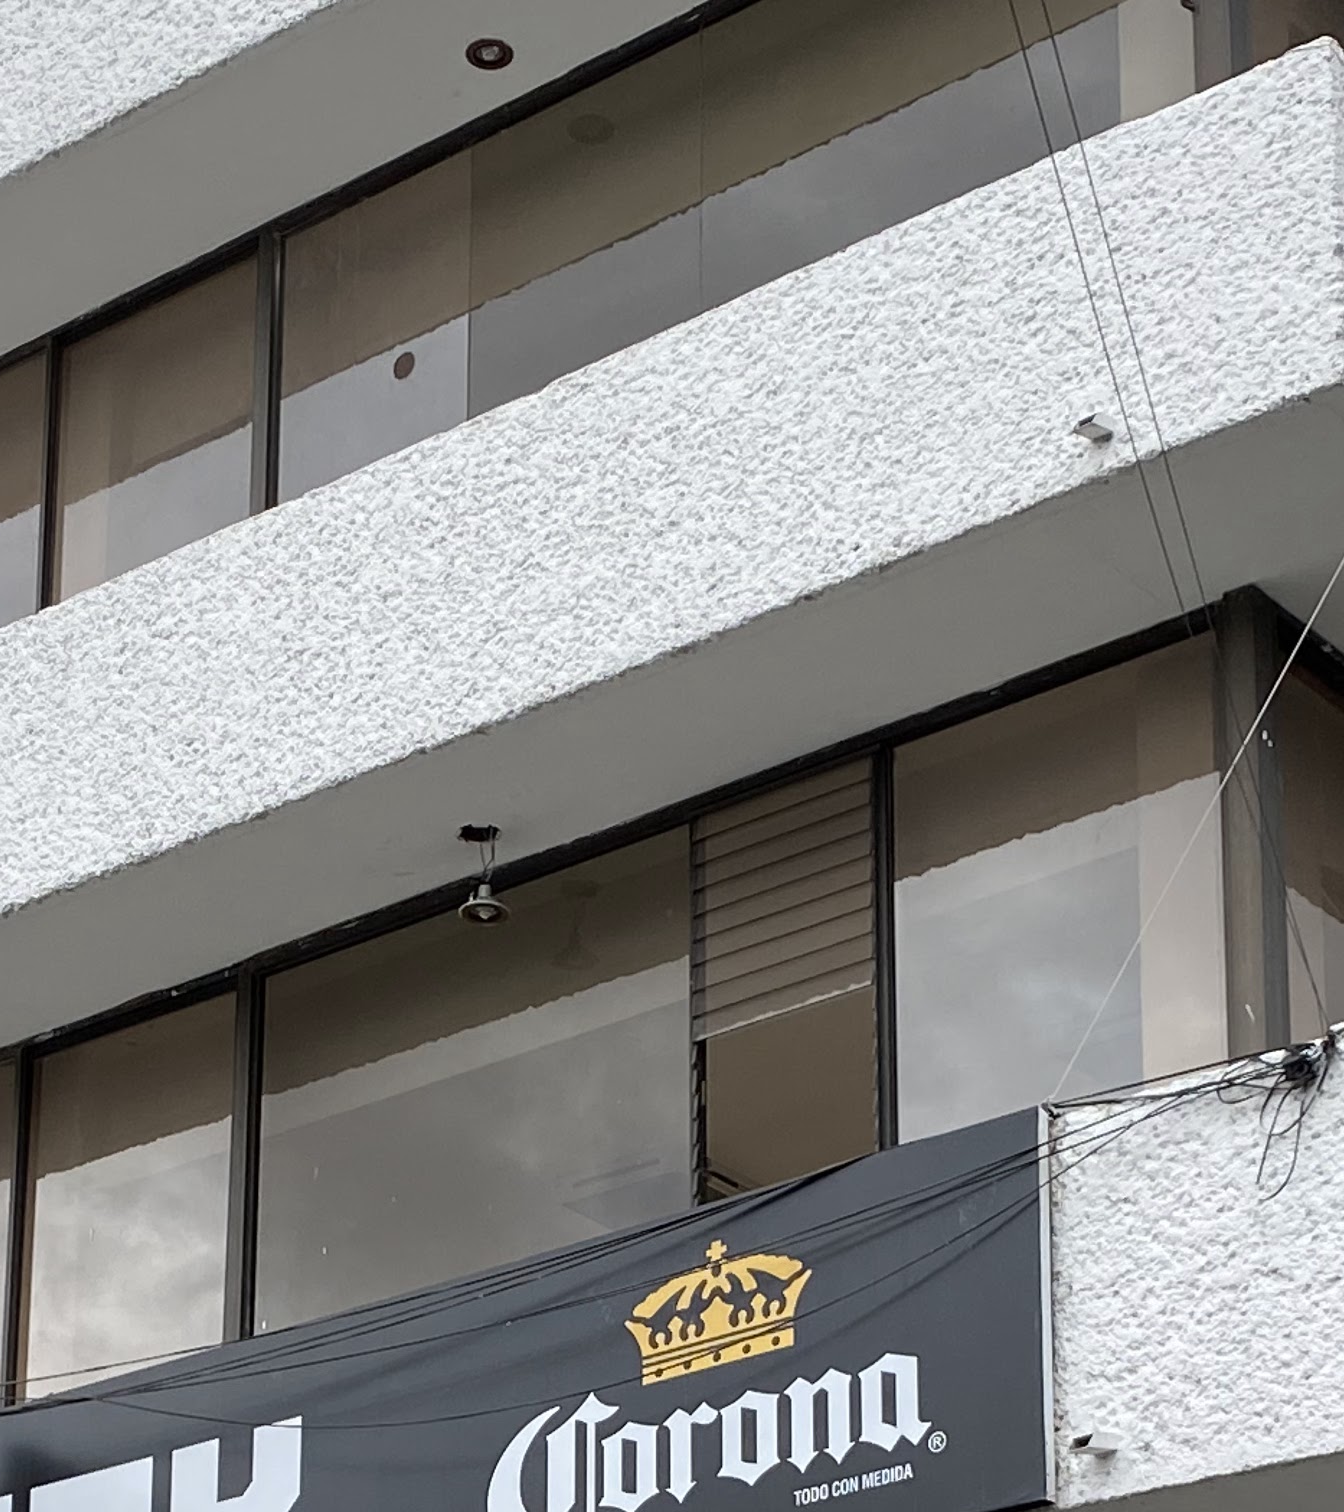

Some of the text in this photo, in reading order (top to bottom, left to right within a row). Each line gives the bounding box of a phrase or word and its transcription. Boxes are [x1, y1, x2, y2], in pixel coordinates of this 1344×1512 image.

[793, 1463, 913, 1507] TODO CON MEDIDA
